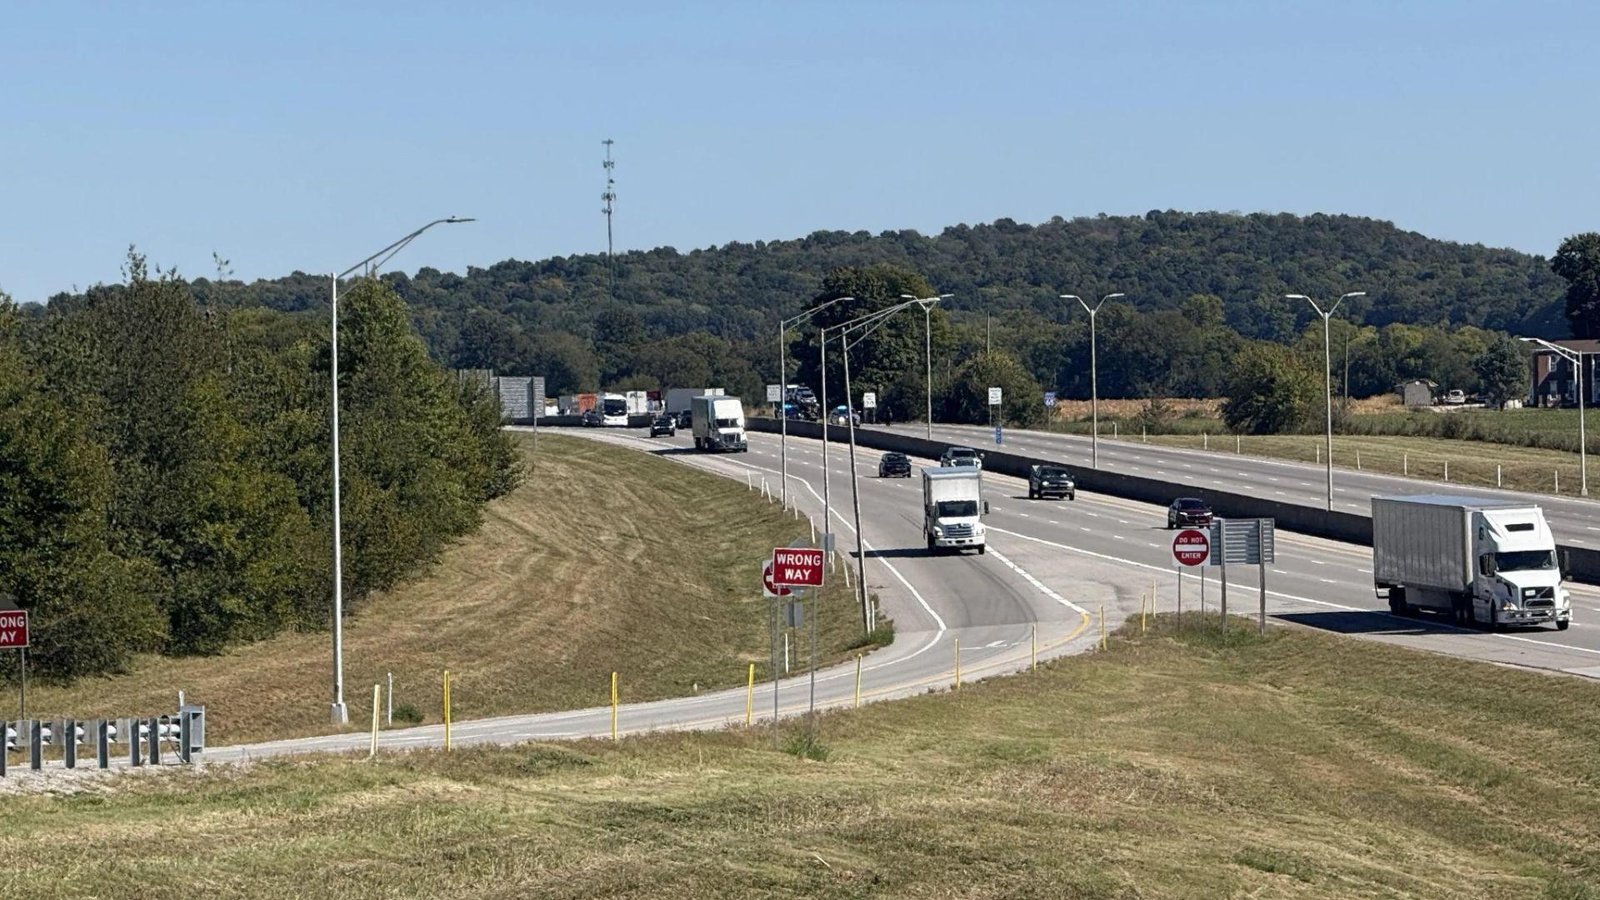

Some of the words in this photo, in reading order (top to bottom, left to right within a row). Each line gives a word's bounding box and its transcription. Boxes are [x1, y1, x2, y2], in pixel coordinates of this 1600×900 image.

[776, 553, 821, 566] WRONG
[784, 568, 812, 580] WAY
[0, 616, 25, 628] ONG
[0, 631, 17, 643] AY
